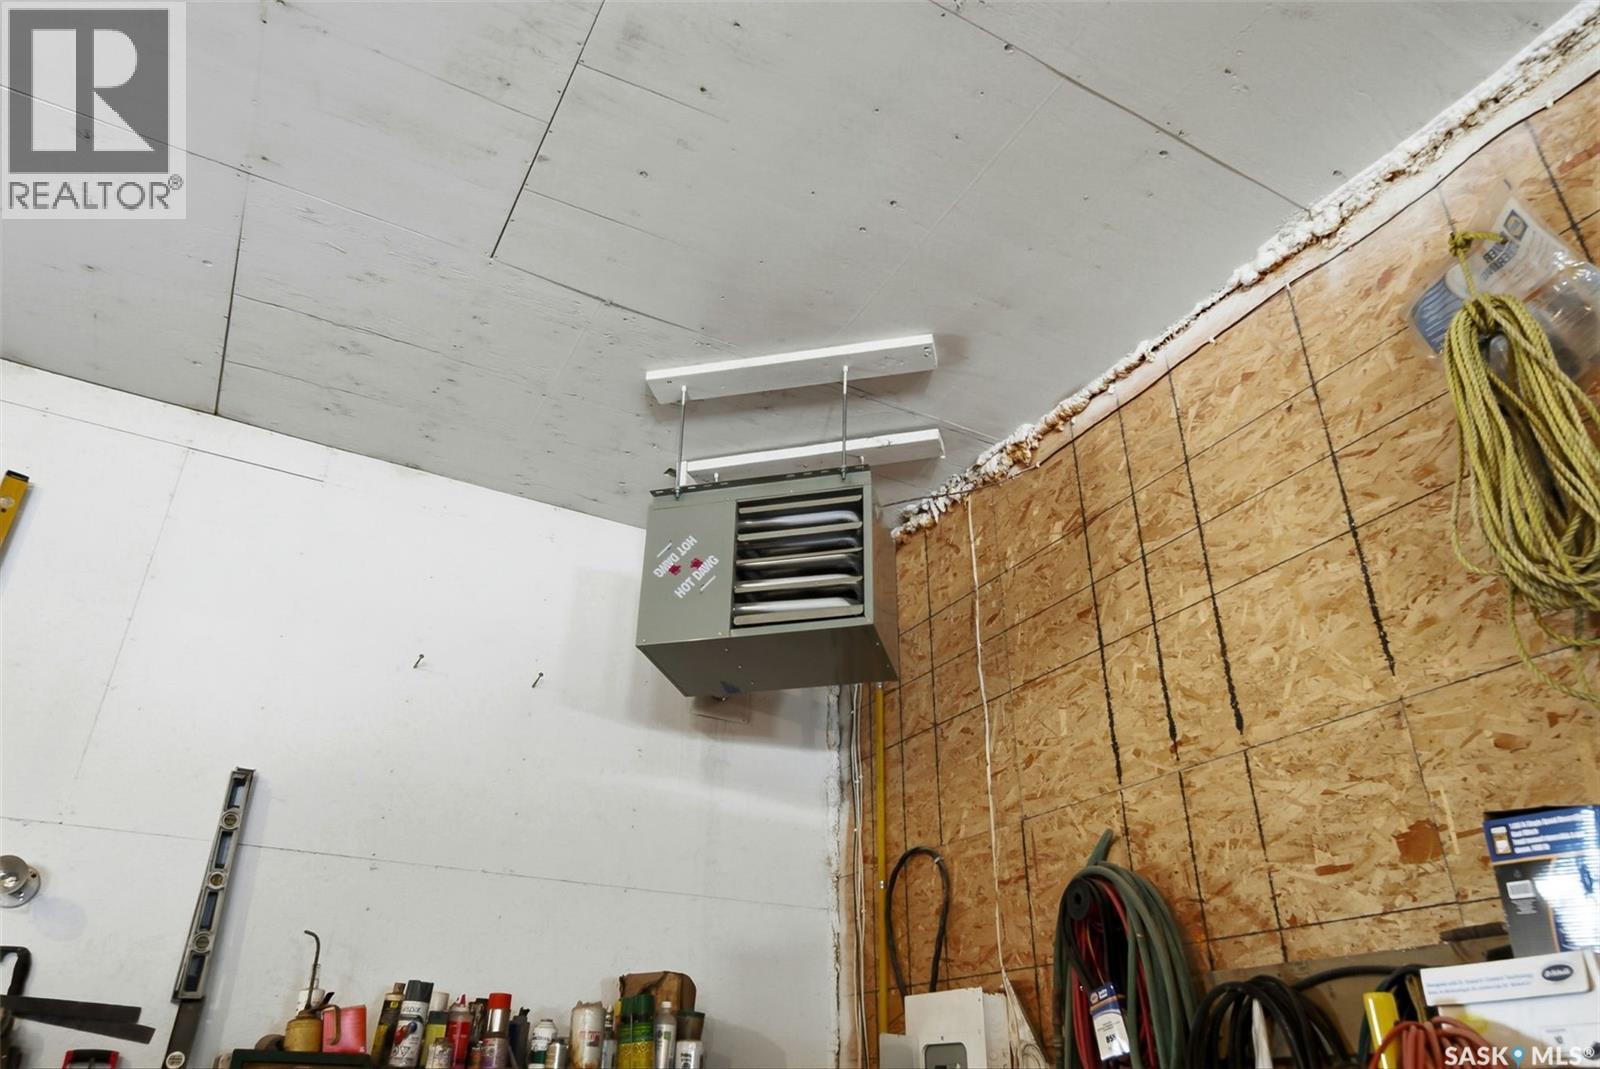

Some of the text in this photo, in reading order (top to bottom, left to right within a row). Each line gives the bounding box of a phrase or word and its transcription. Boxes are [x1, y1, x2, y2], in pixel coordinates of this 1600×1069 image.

[676, 535, 698, 556] HOT
[674, 555, 720, 598] HOT DAWG
